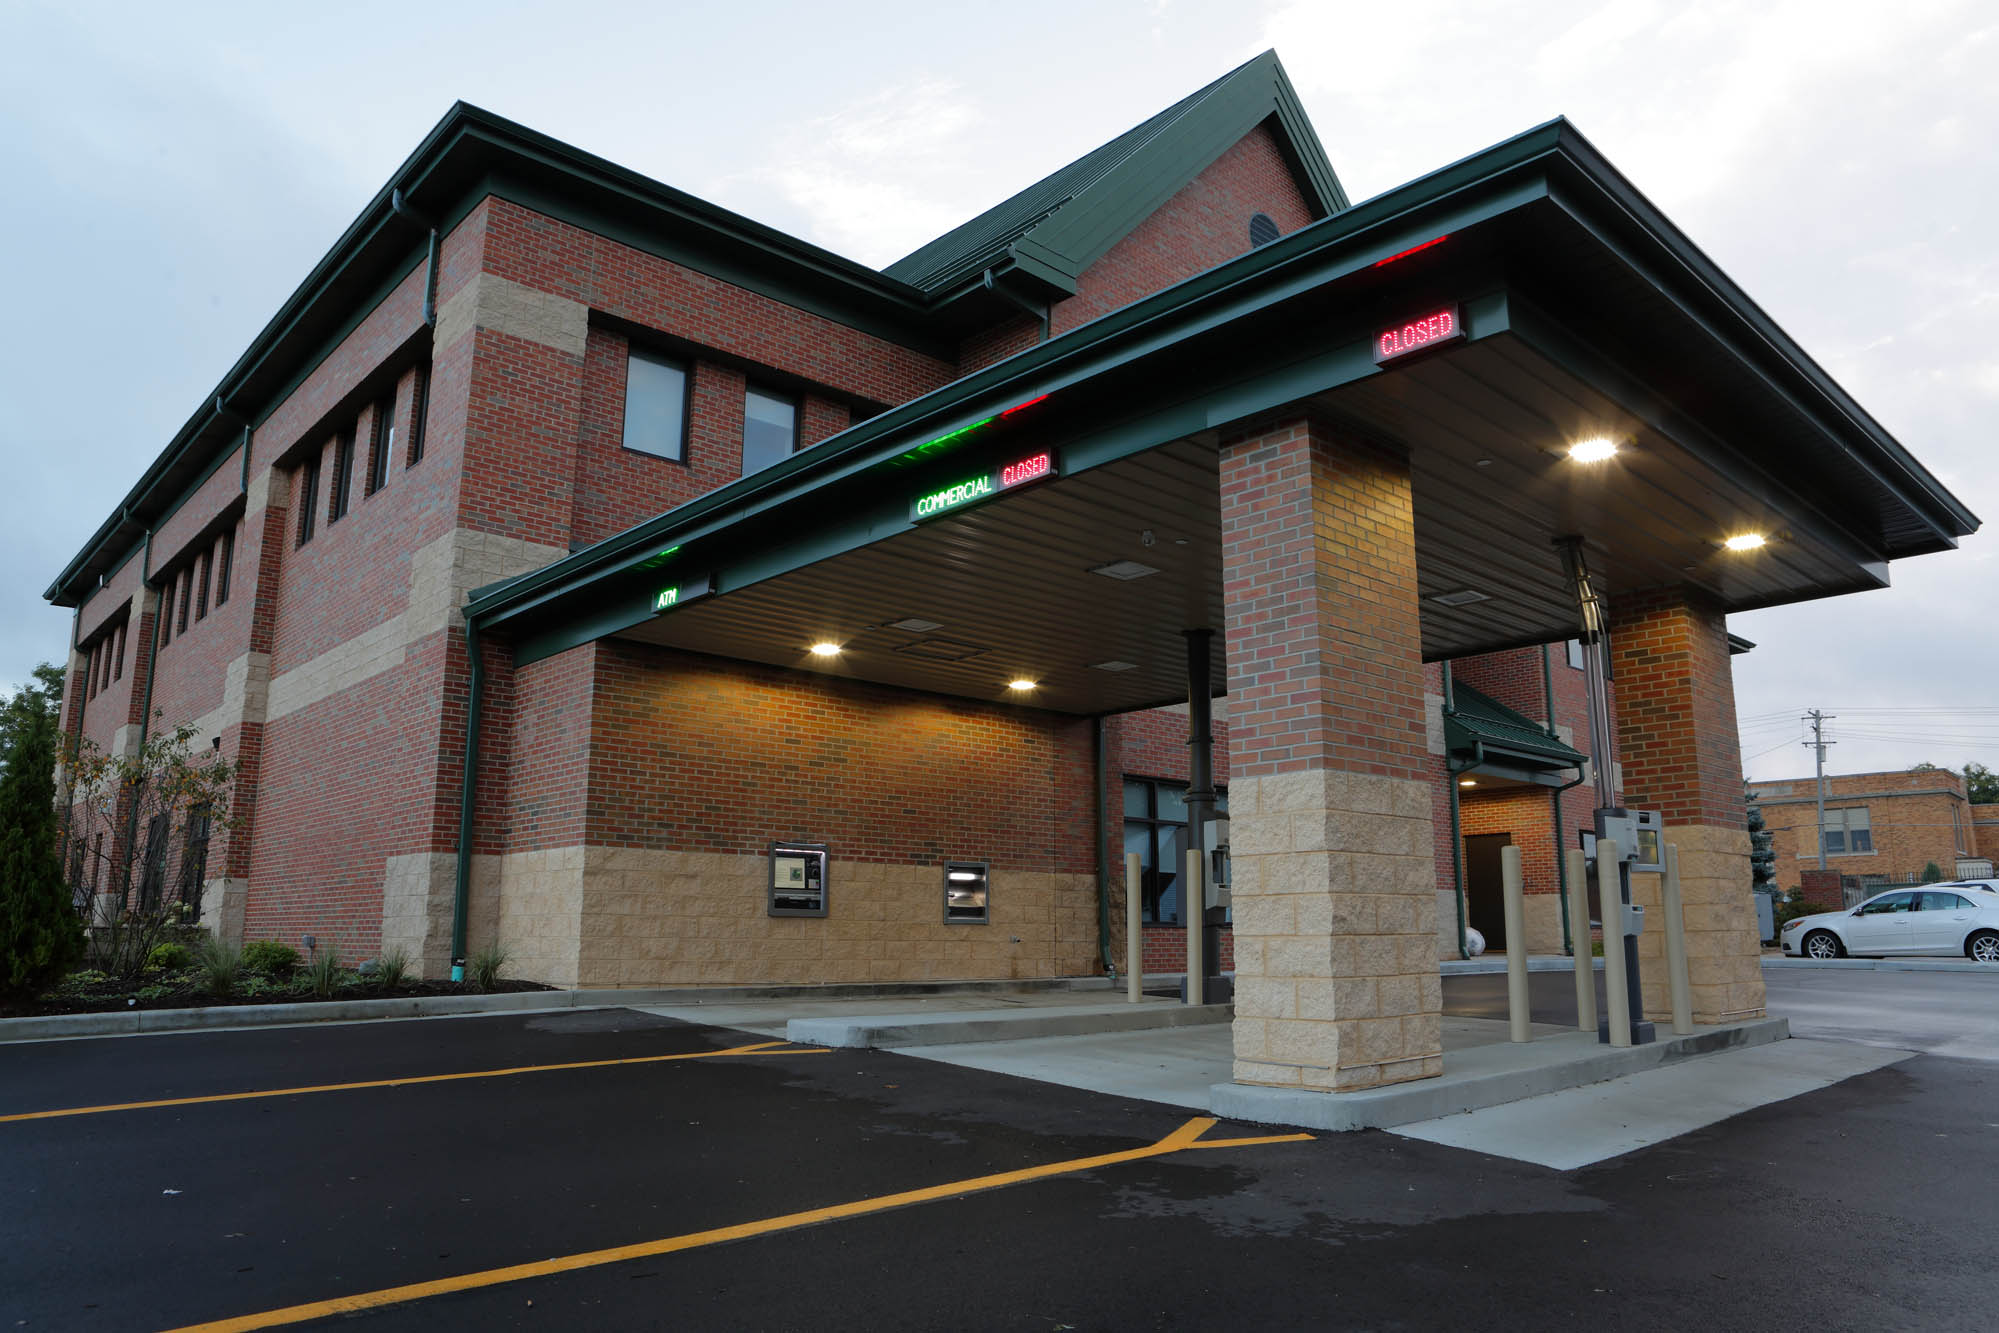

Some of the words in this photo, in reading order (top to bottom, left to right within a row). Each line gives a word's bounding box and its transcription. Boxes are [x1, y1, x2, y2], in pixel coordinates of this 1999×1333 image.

[1381, 312, 1453, 355] CLOSED
[917, 475, 992, 516] COMMERCIAL
[1002, 454, 1048, 485] CLOSED
[657, 588, 677, 608] ATM
